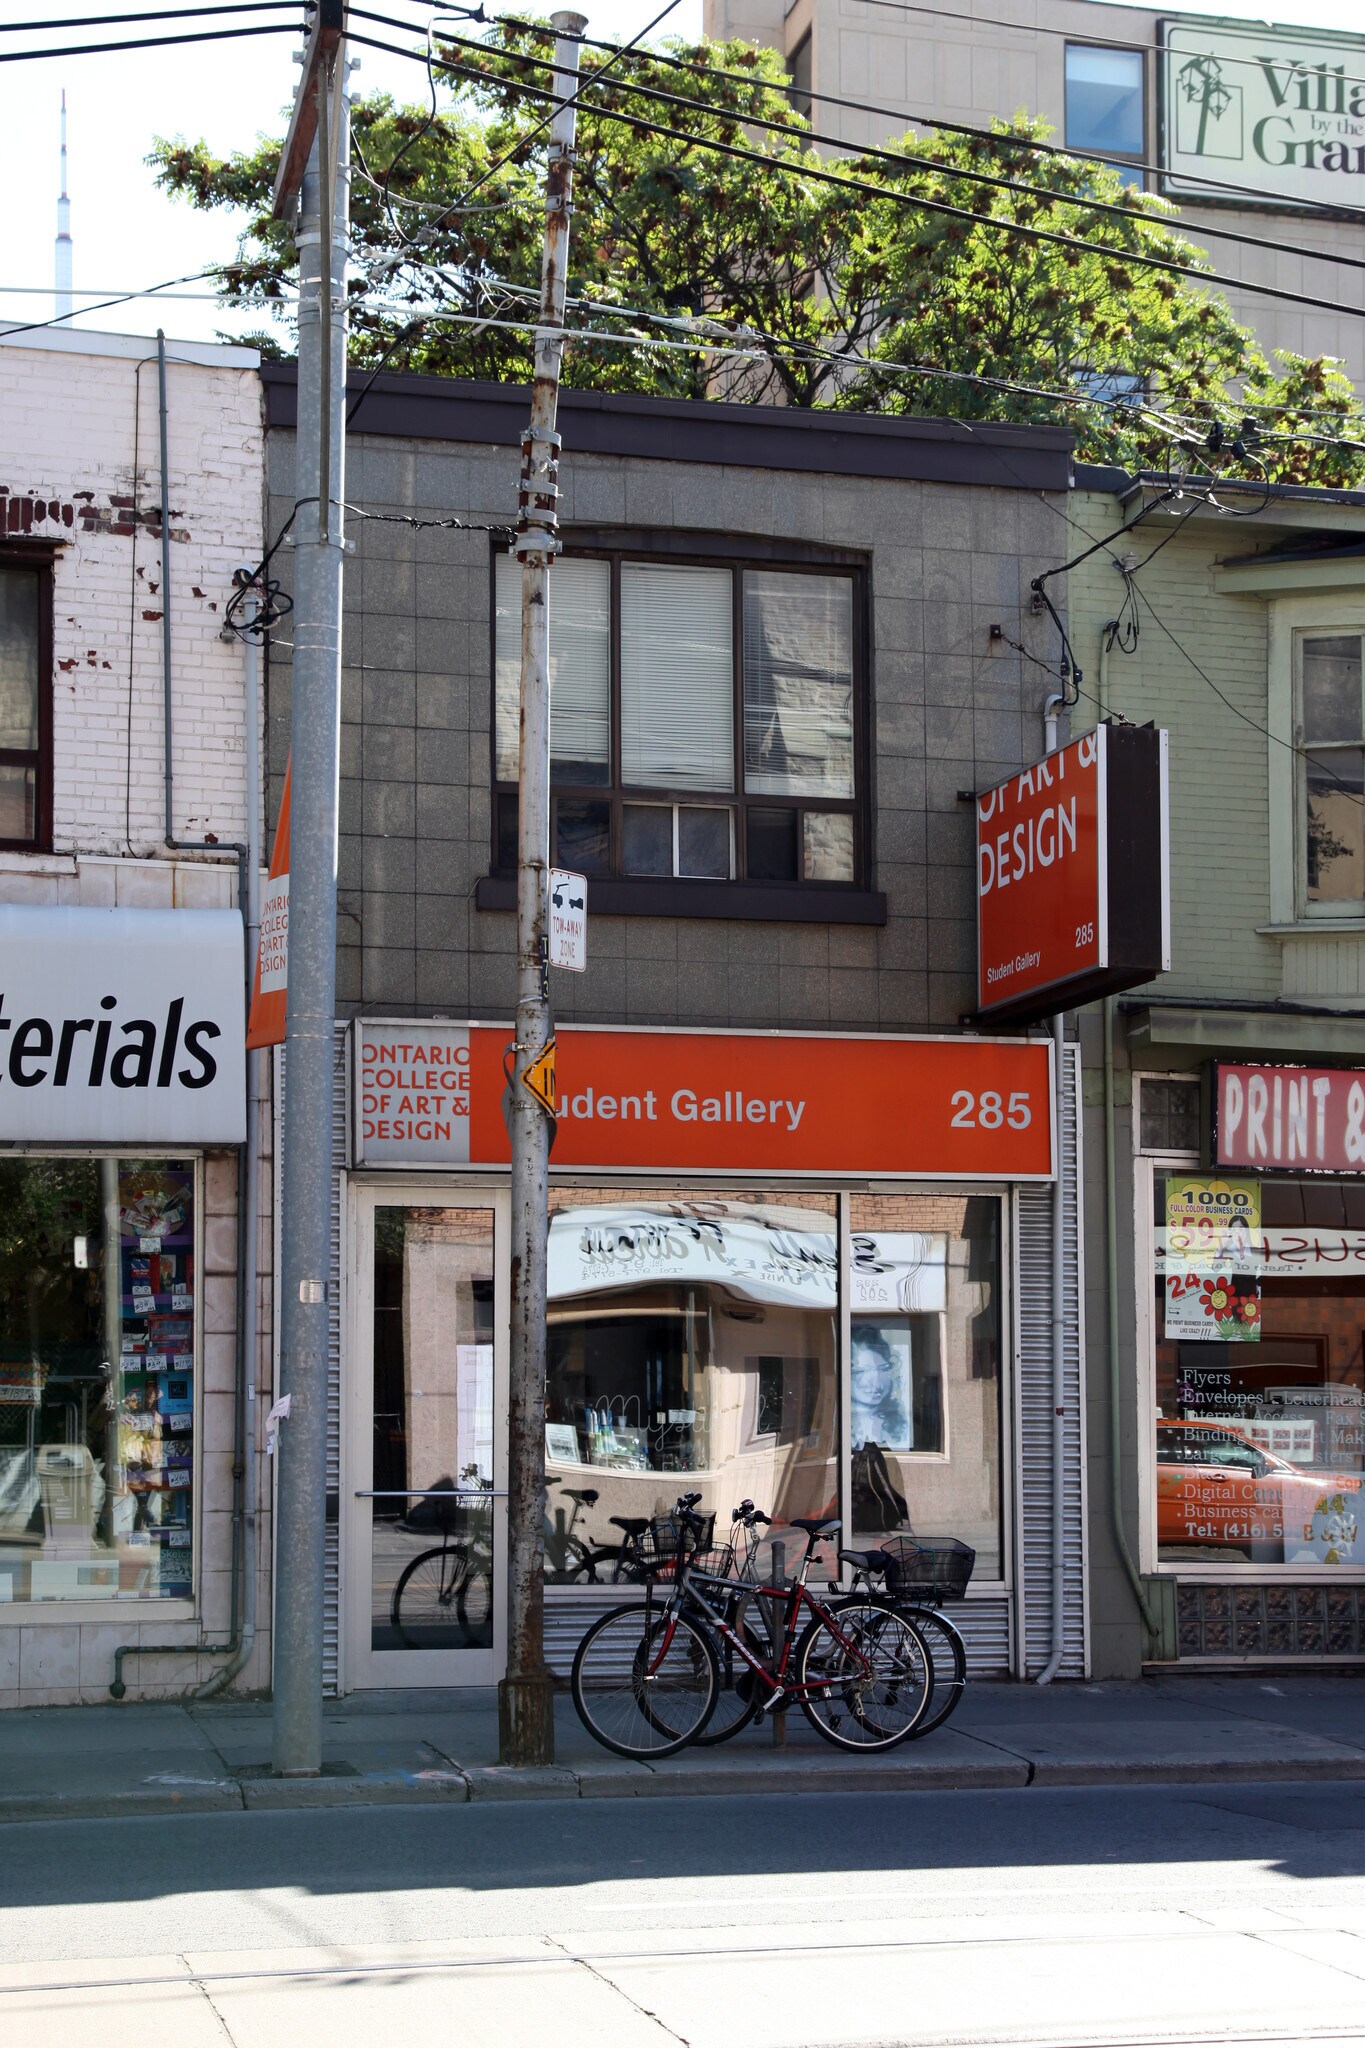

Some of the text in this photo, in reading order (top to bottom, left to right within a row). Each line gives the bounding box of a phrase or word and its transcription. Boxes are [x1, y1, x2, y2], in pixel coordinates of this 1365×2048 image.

[1311, 114, 1365, 137] by the
[979, 796, 1077, 897] DESIGN
[553, 915, 583, 938] TOW-AWAY
[1075, 921, 1094, 949] 285
[560, 939, 576, 959] ZONE
[987, 950, 1041, 985] Student Gallery
[362, 1043, 470, 1066] ONTARIO
[362, 1069, 470, 1091] COLLEGE
[362, 1094, 470, 1117] OF ART &
[556, 1088, 1032, 1131] udent Gallery 285
[1224, 1073, 1365, 1163] PRINT &
[363, 1119, 451, 1141] DESIGN
[1182, 1191, 1249, 1206] 1000
[1170, 1204, 1253, 1216] FULL COLOR BUSINESS CARDS
[1166, 1268, 1202, 1299] 24
[1183, 1369, 1231, 1387] Flyers
[1183, 1388, 1264, 1407] Envelopes
[1183, 1407, 1247, 1422] Internet
[1253, 1406, 1306, 1422] Access
[1326, 1410, 1354, 1426] Fax
[1183, 1427, 1246, 1446] Binding
[1183, 1445, 1226, 1465] Large
[1183, 1484, 1236, 1503] Digital
[1183, 1503, 1257, 1518] Business
[1185, 1521, 1218, 1537] Tel:
[1223, 1521, 1267, 1541] (416)
